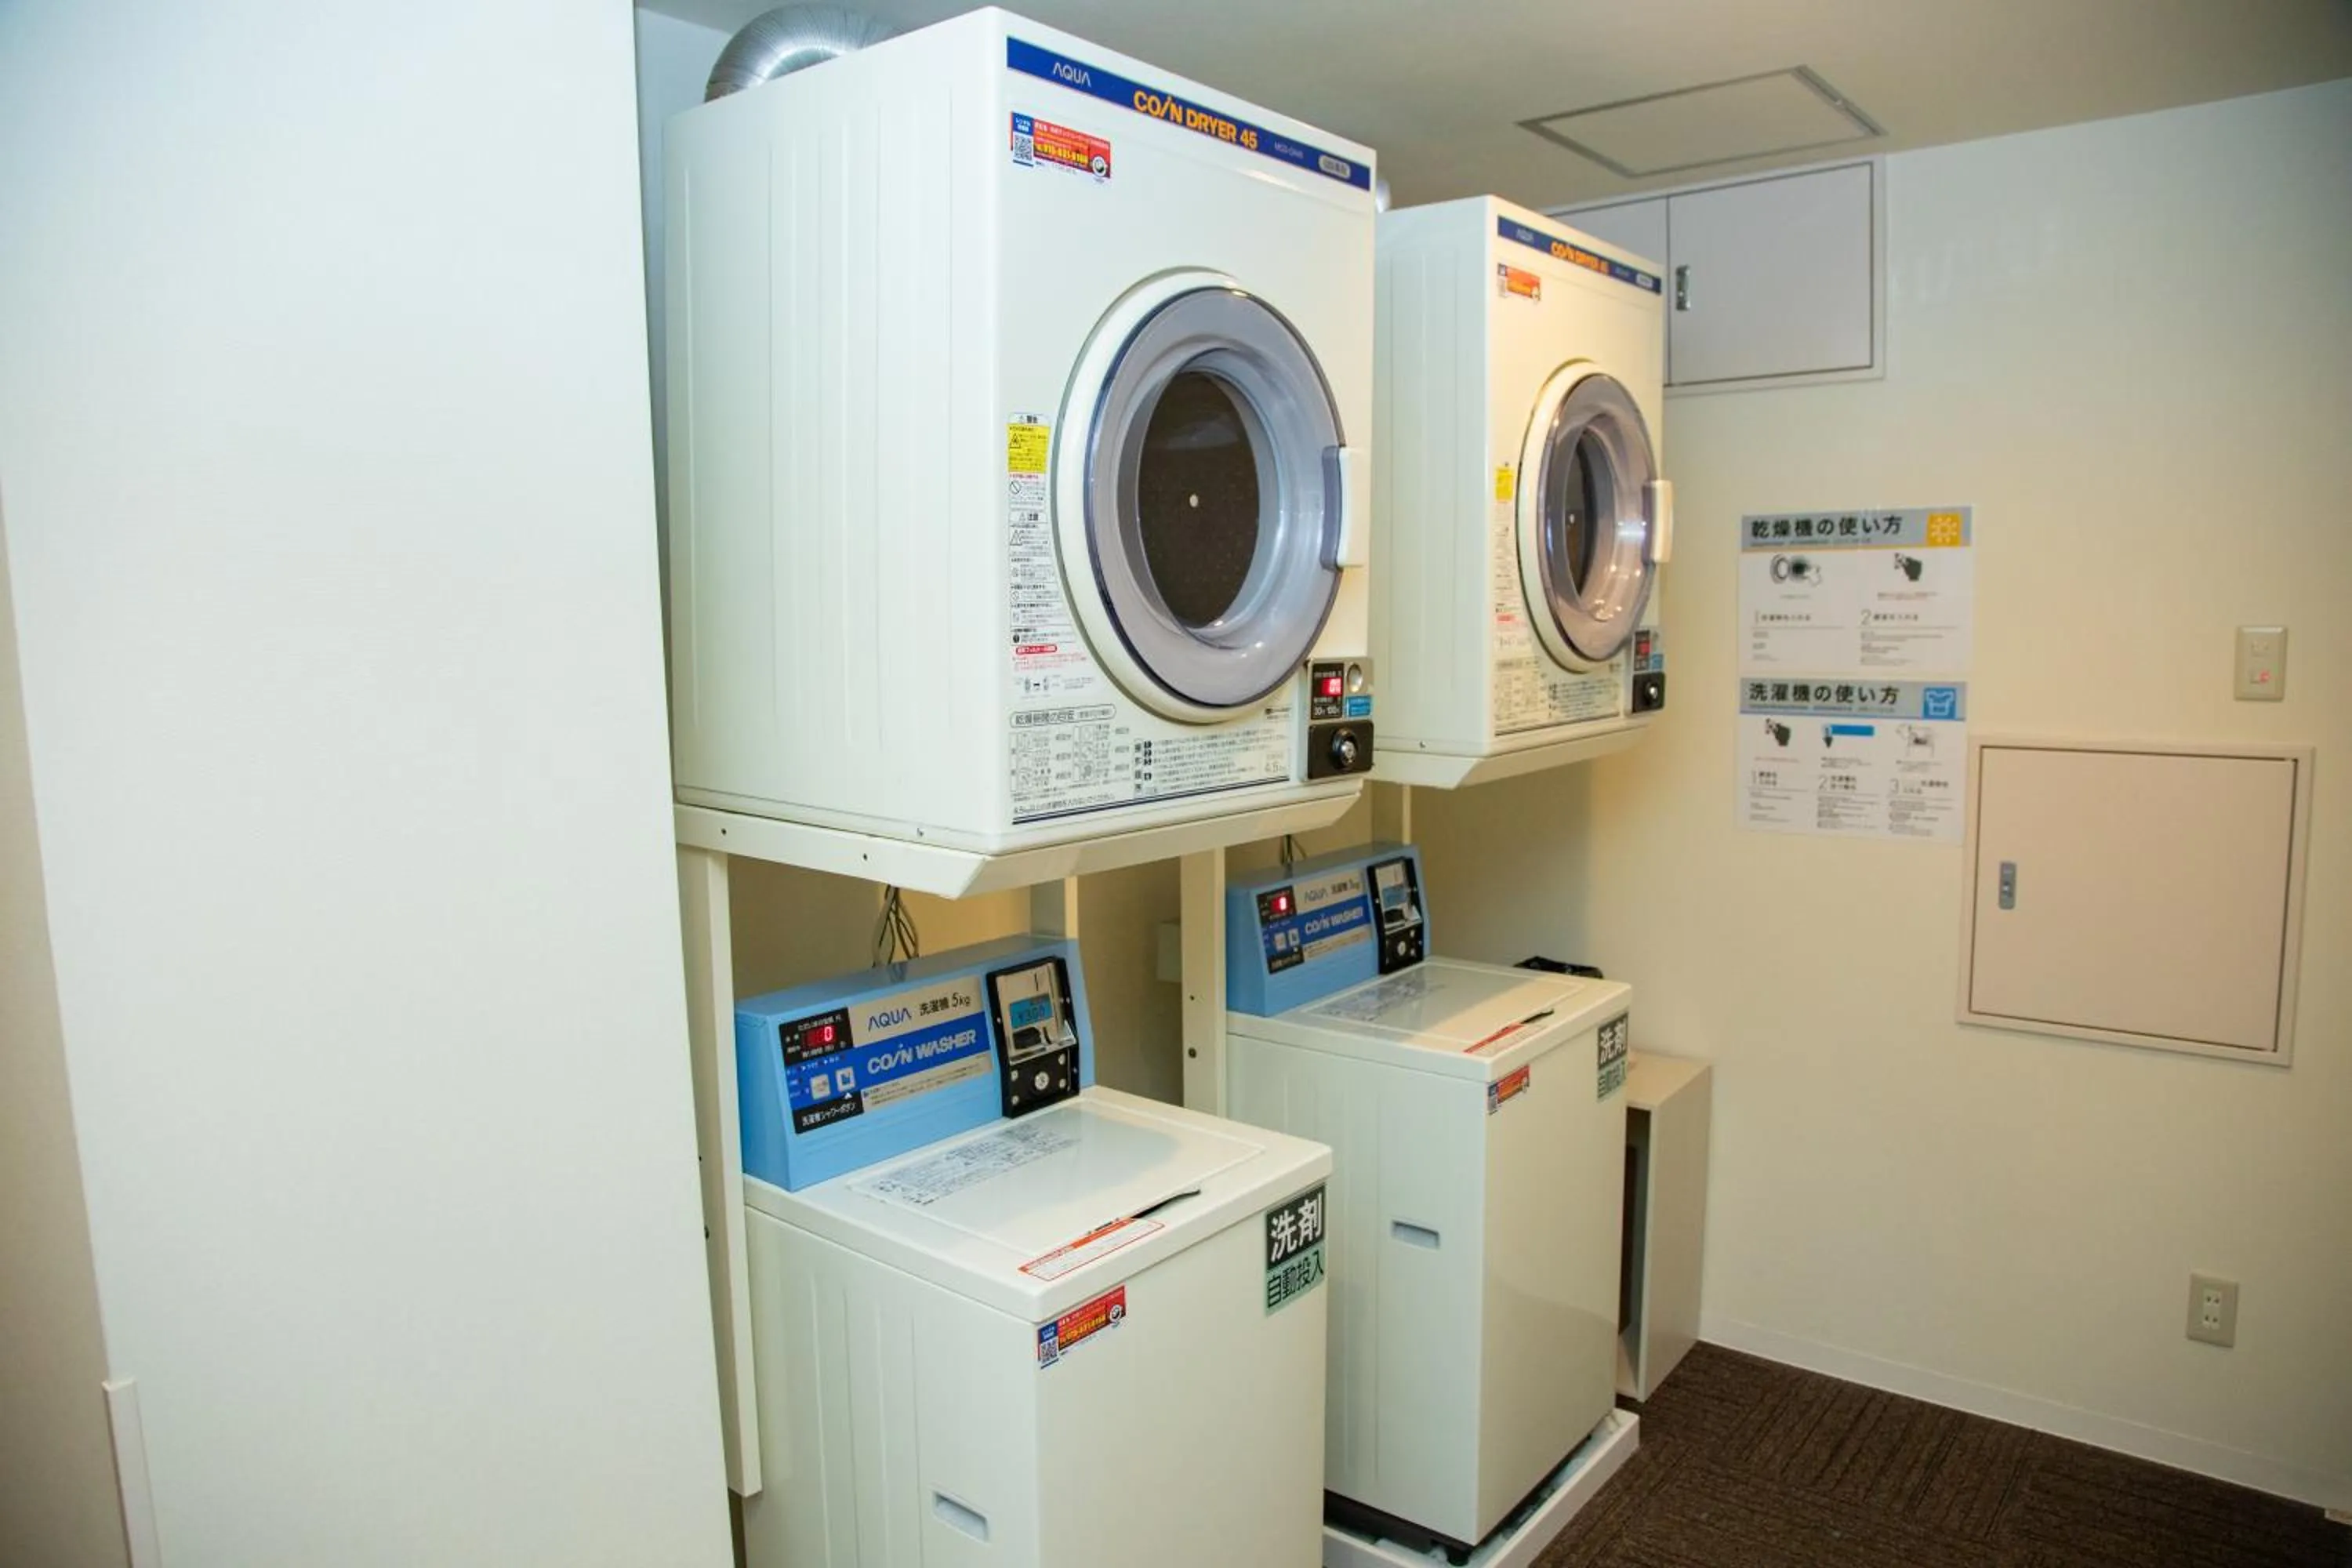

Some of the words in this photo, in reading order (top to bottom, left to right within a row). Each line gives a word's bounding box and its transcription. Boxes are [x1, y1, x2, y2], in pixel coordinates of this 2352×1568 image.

[1053, 62, 1091, 88] AQUA
[1185, 107, 1236, 143] DRYER
[1240, 128, 1258, 151] 45
[1751, 514, 1903, 539] 乾燥機の使い方
[1749, 682, 1900, 705] 洗濯機の使い方
[868, 1007, 912, 1033] AQUA
[952, 992, 971, 1007] 5kg
[825, 1026, 833, 1042] 0
[916, 1029, 976, 1060] WASHER
[1270, 1192, 1323, 1263] 洗剤
[1267, 1250, 1324, 1308] 自動投入
